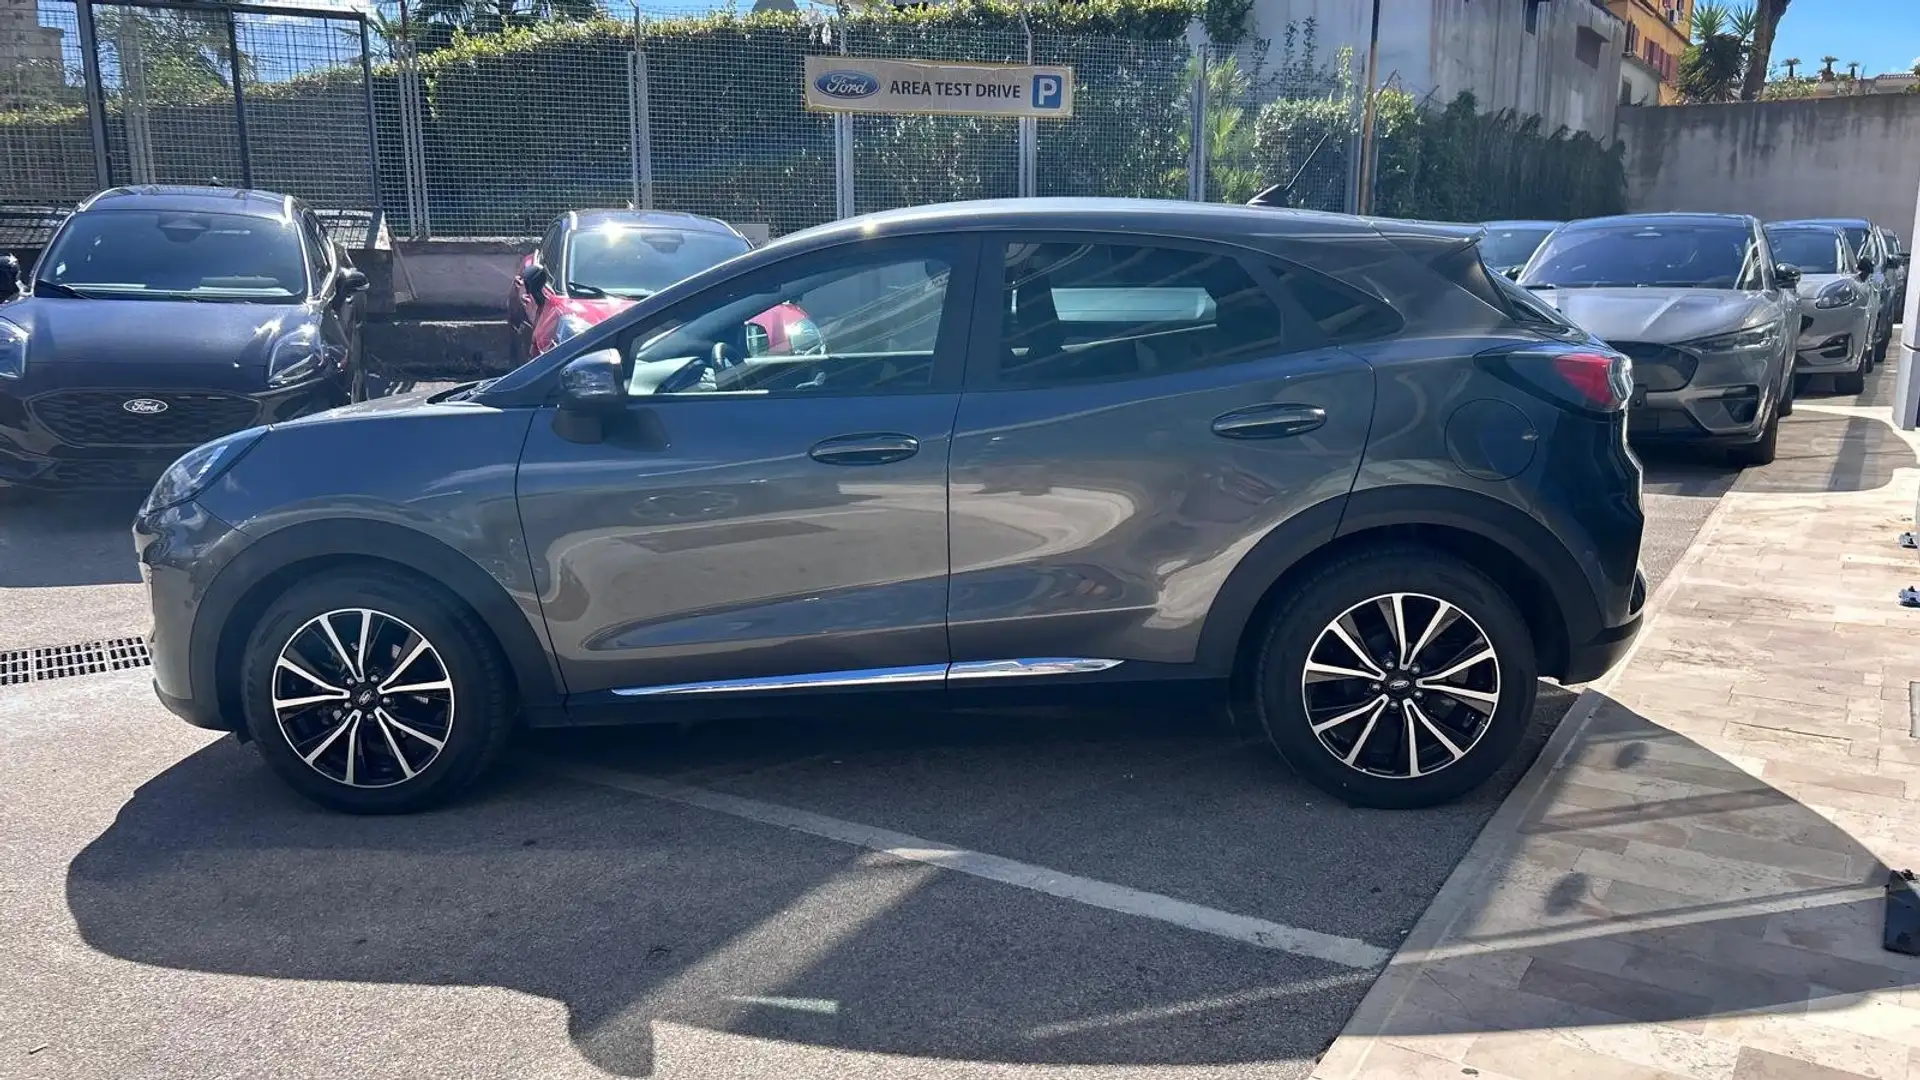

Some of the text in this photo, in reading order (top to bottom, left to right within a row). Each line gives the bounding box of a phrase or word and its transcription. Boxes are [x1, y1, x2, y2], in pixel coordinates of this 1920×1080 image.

[826, 74, 868, 94] Ford
[890, 80, 1020, 98] AREA TEST DRIVE
[1038, 78, 1057, 105] P
[132, 400, 159, 411] Ford
